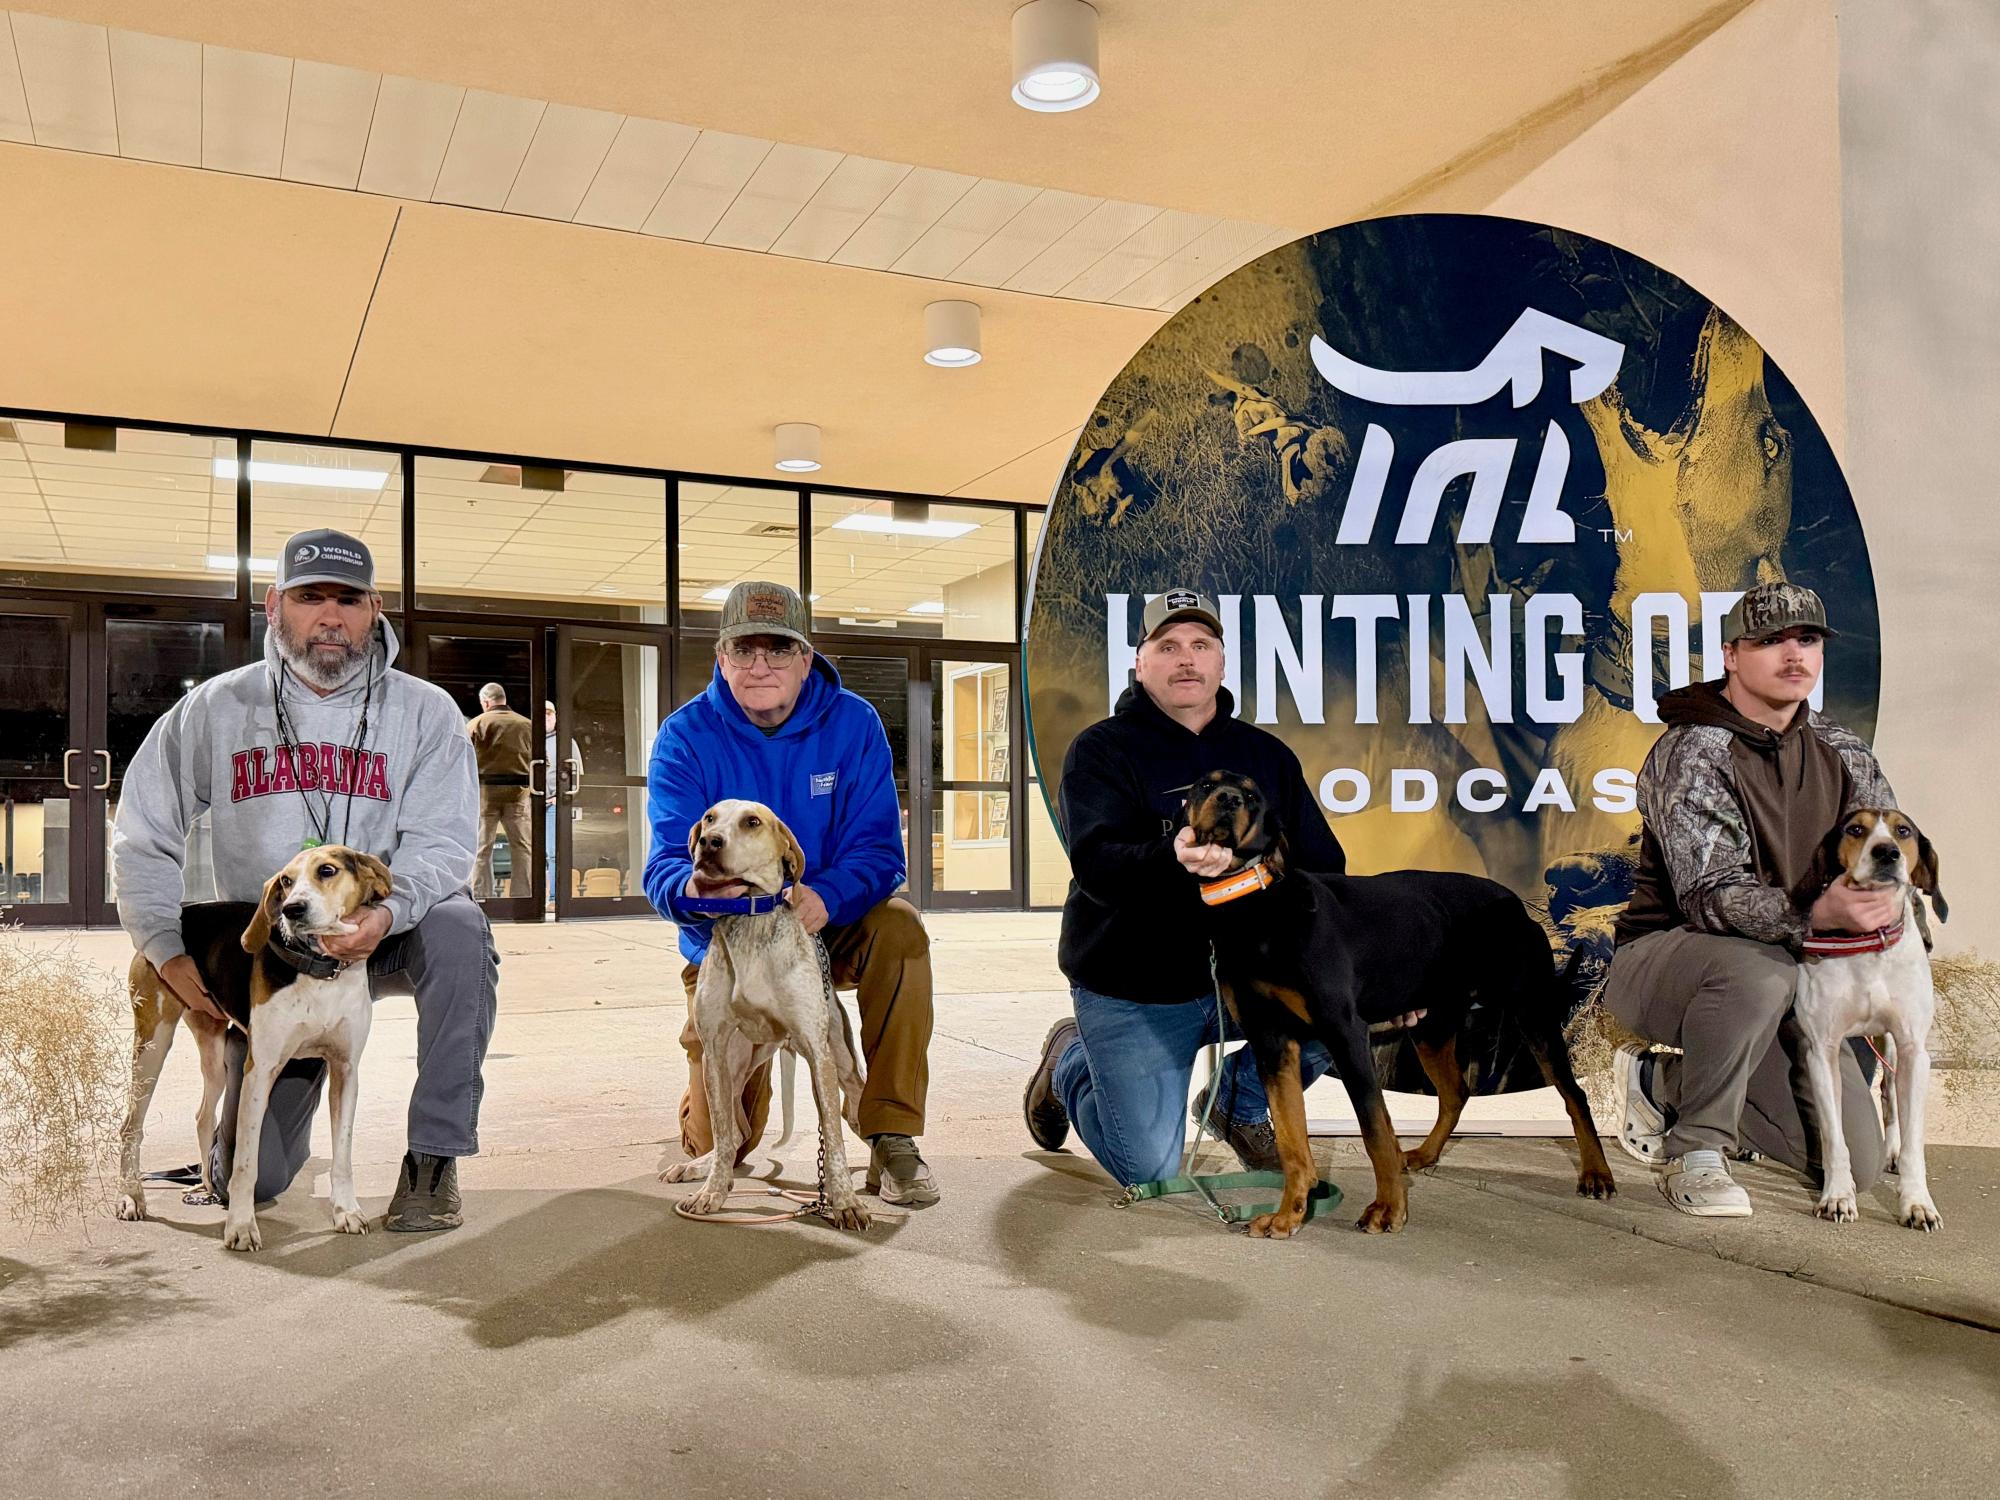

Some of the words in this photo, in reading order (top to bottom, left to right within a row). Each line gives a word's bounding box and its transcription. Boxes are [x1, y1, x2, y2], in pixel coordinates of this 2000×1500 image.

[1598, 529, 1633, 543] TM
[322, 546, 362, 560] WORLD
[231, 741, 392, 803] ALABAMA
[1319, 768, 1638, 813] ODCAS
